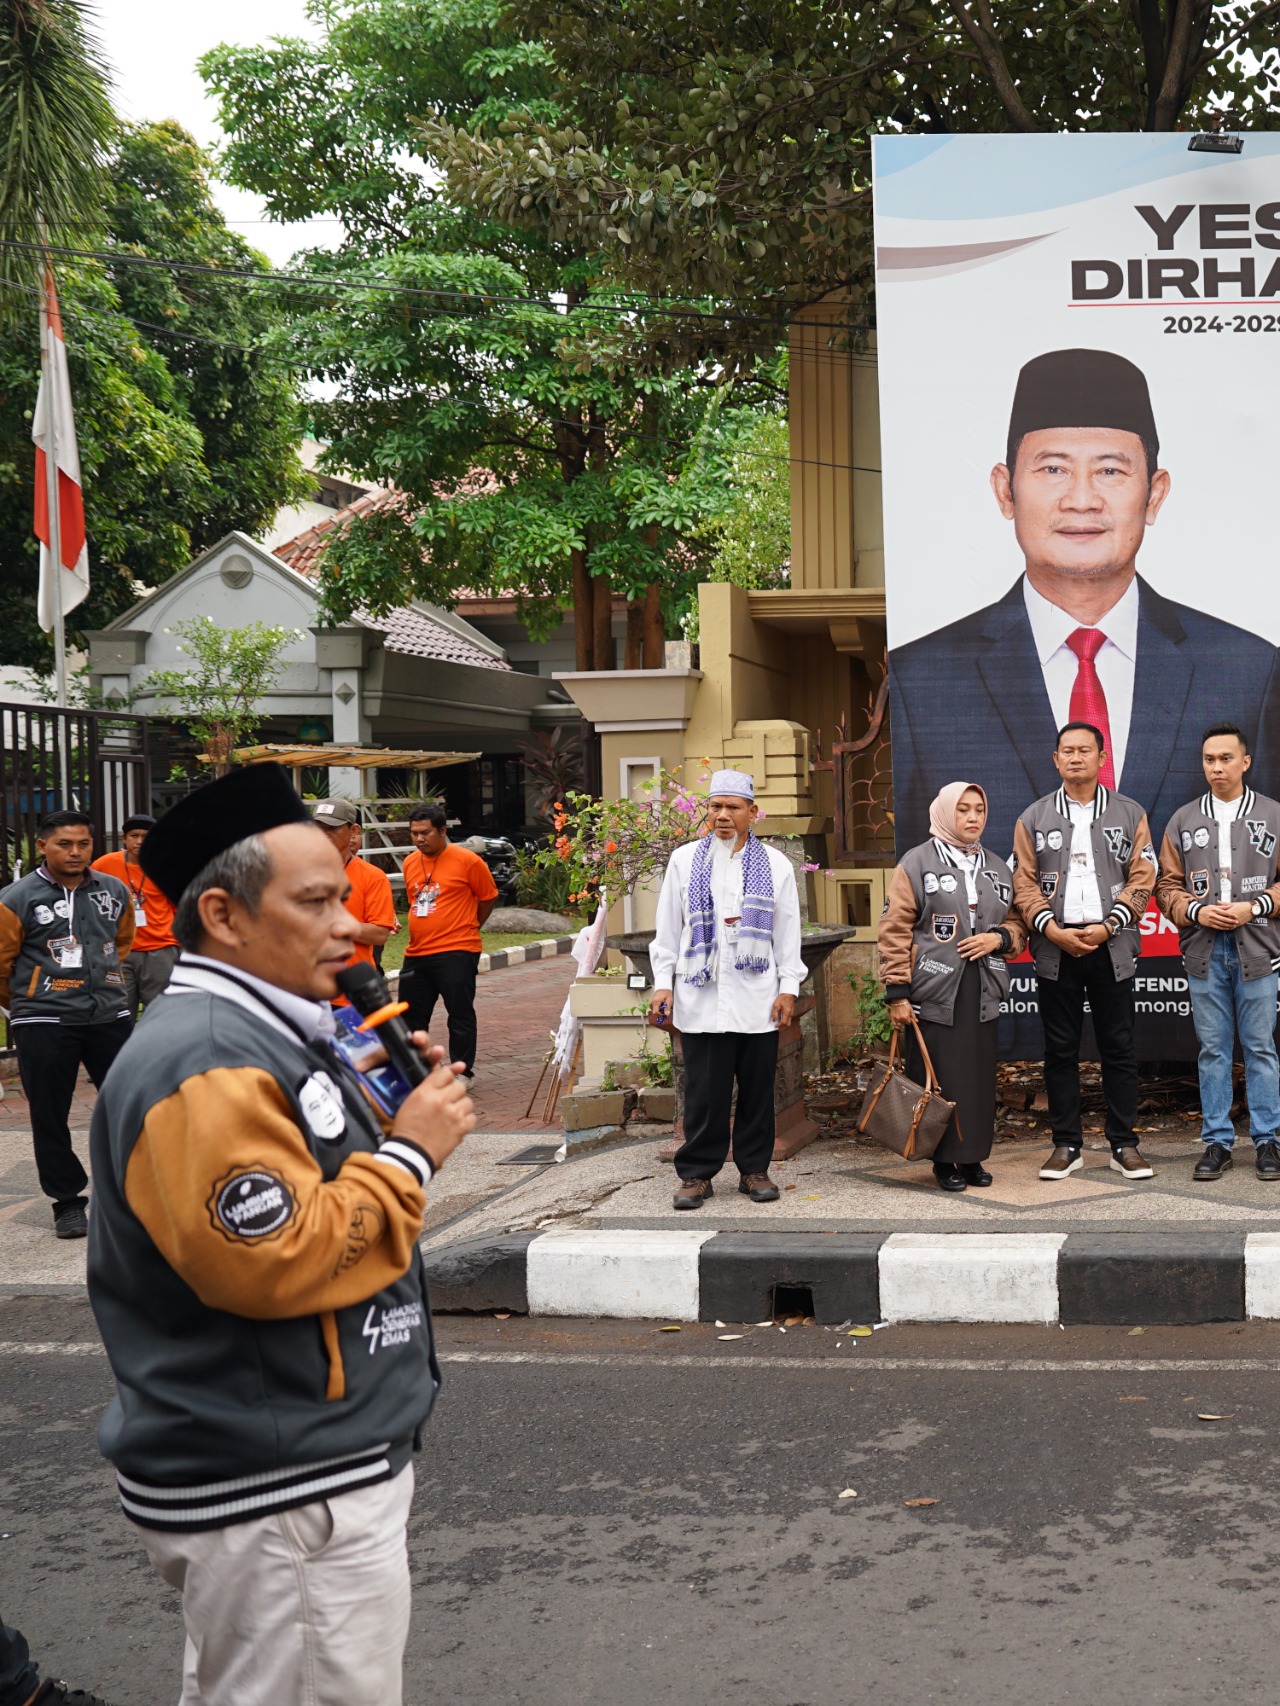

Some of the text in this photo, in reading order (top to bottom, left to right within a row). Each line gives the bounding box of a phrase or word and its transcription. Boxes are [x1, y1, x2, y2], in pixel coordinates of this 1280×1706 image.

[1131, 977, 1189, 992] FEND
[999, 998, 1039, 1013] alon
[232, 1196, 284, 1225] PANGAN
[381, 1329, 411, 1347] EMAS
